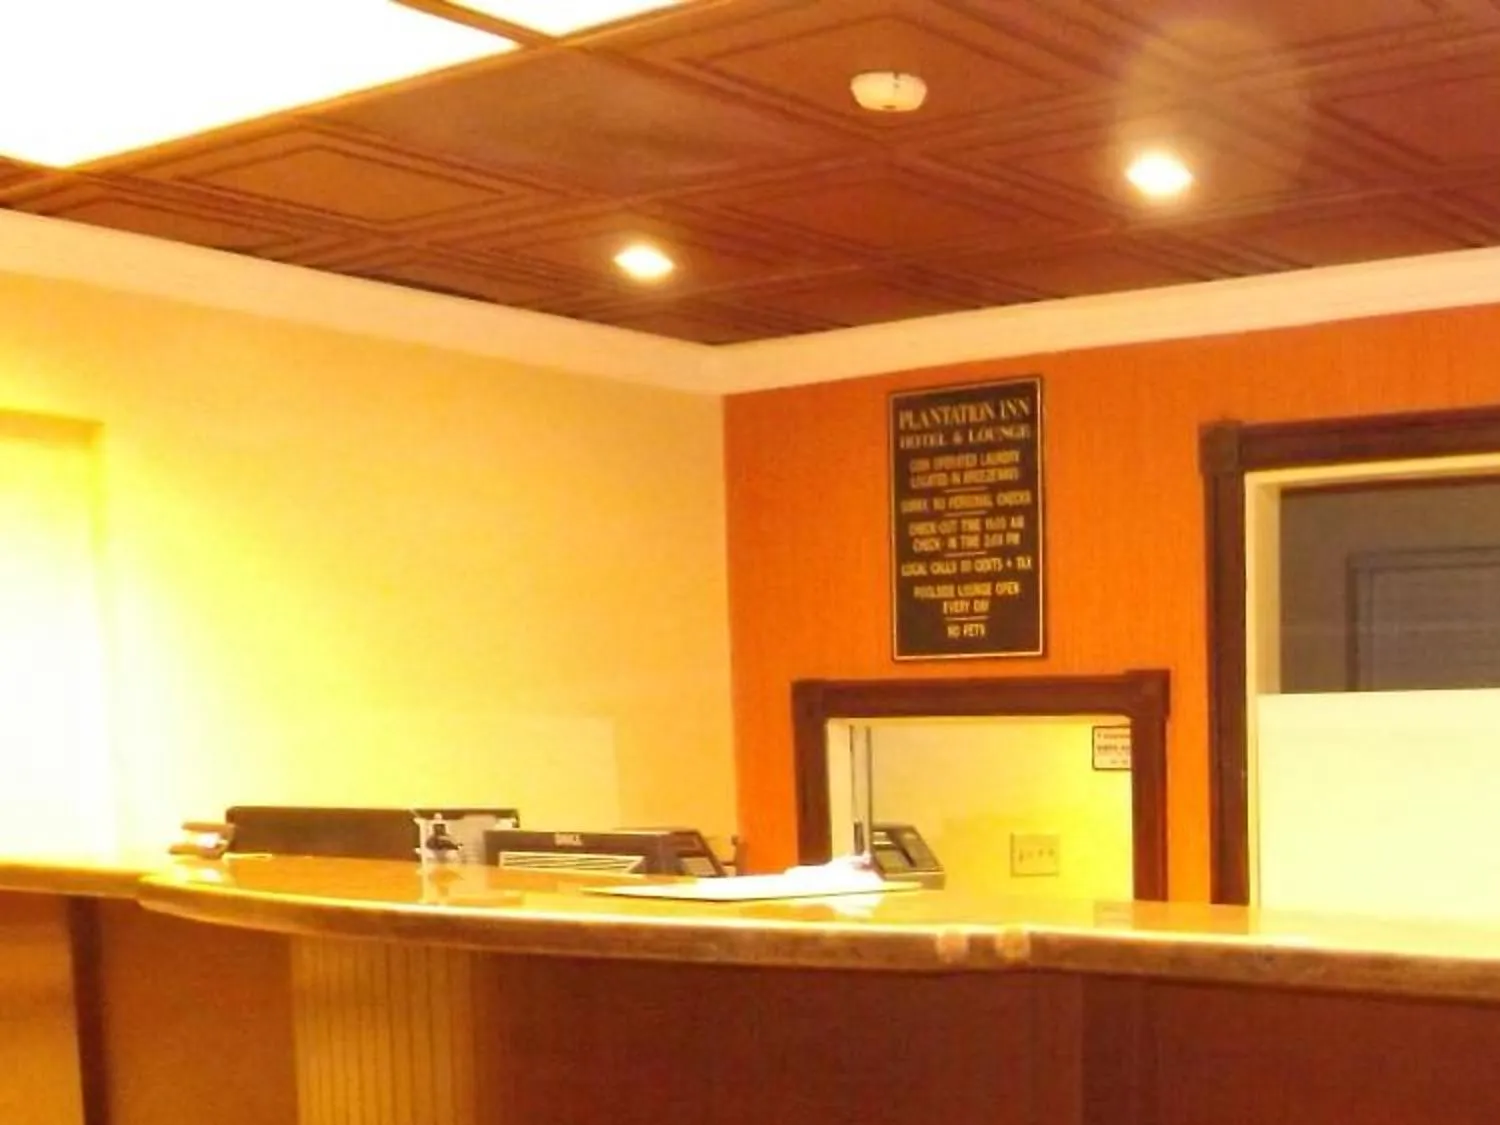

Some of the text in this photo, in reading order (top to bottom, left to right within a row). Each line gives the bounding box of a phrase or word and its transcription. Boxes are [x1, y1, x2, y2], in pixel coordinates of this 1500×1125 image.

[899, 397, 1030, 430] PLANTATION INN
[900, 423, 1031, 449] HOTEL & LOUNGE
[961, 534, 979, 549] TIME
[901, 562, 928, 577] LOCAL
[930, 560, 957, 575] CALLS
[974, 557, 1003, 572] CENTS
[995, 581, 1020, 595] OPEN
[947, 625, 960, 639] NO
